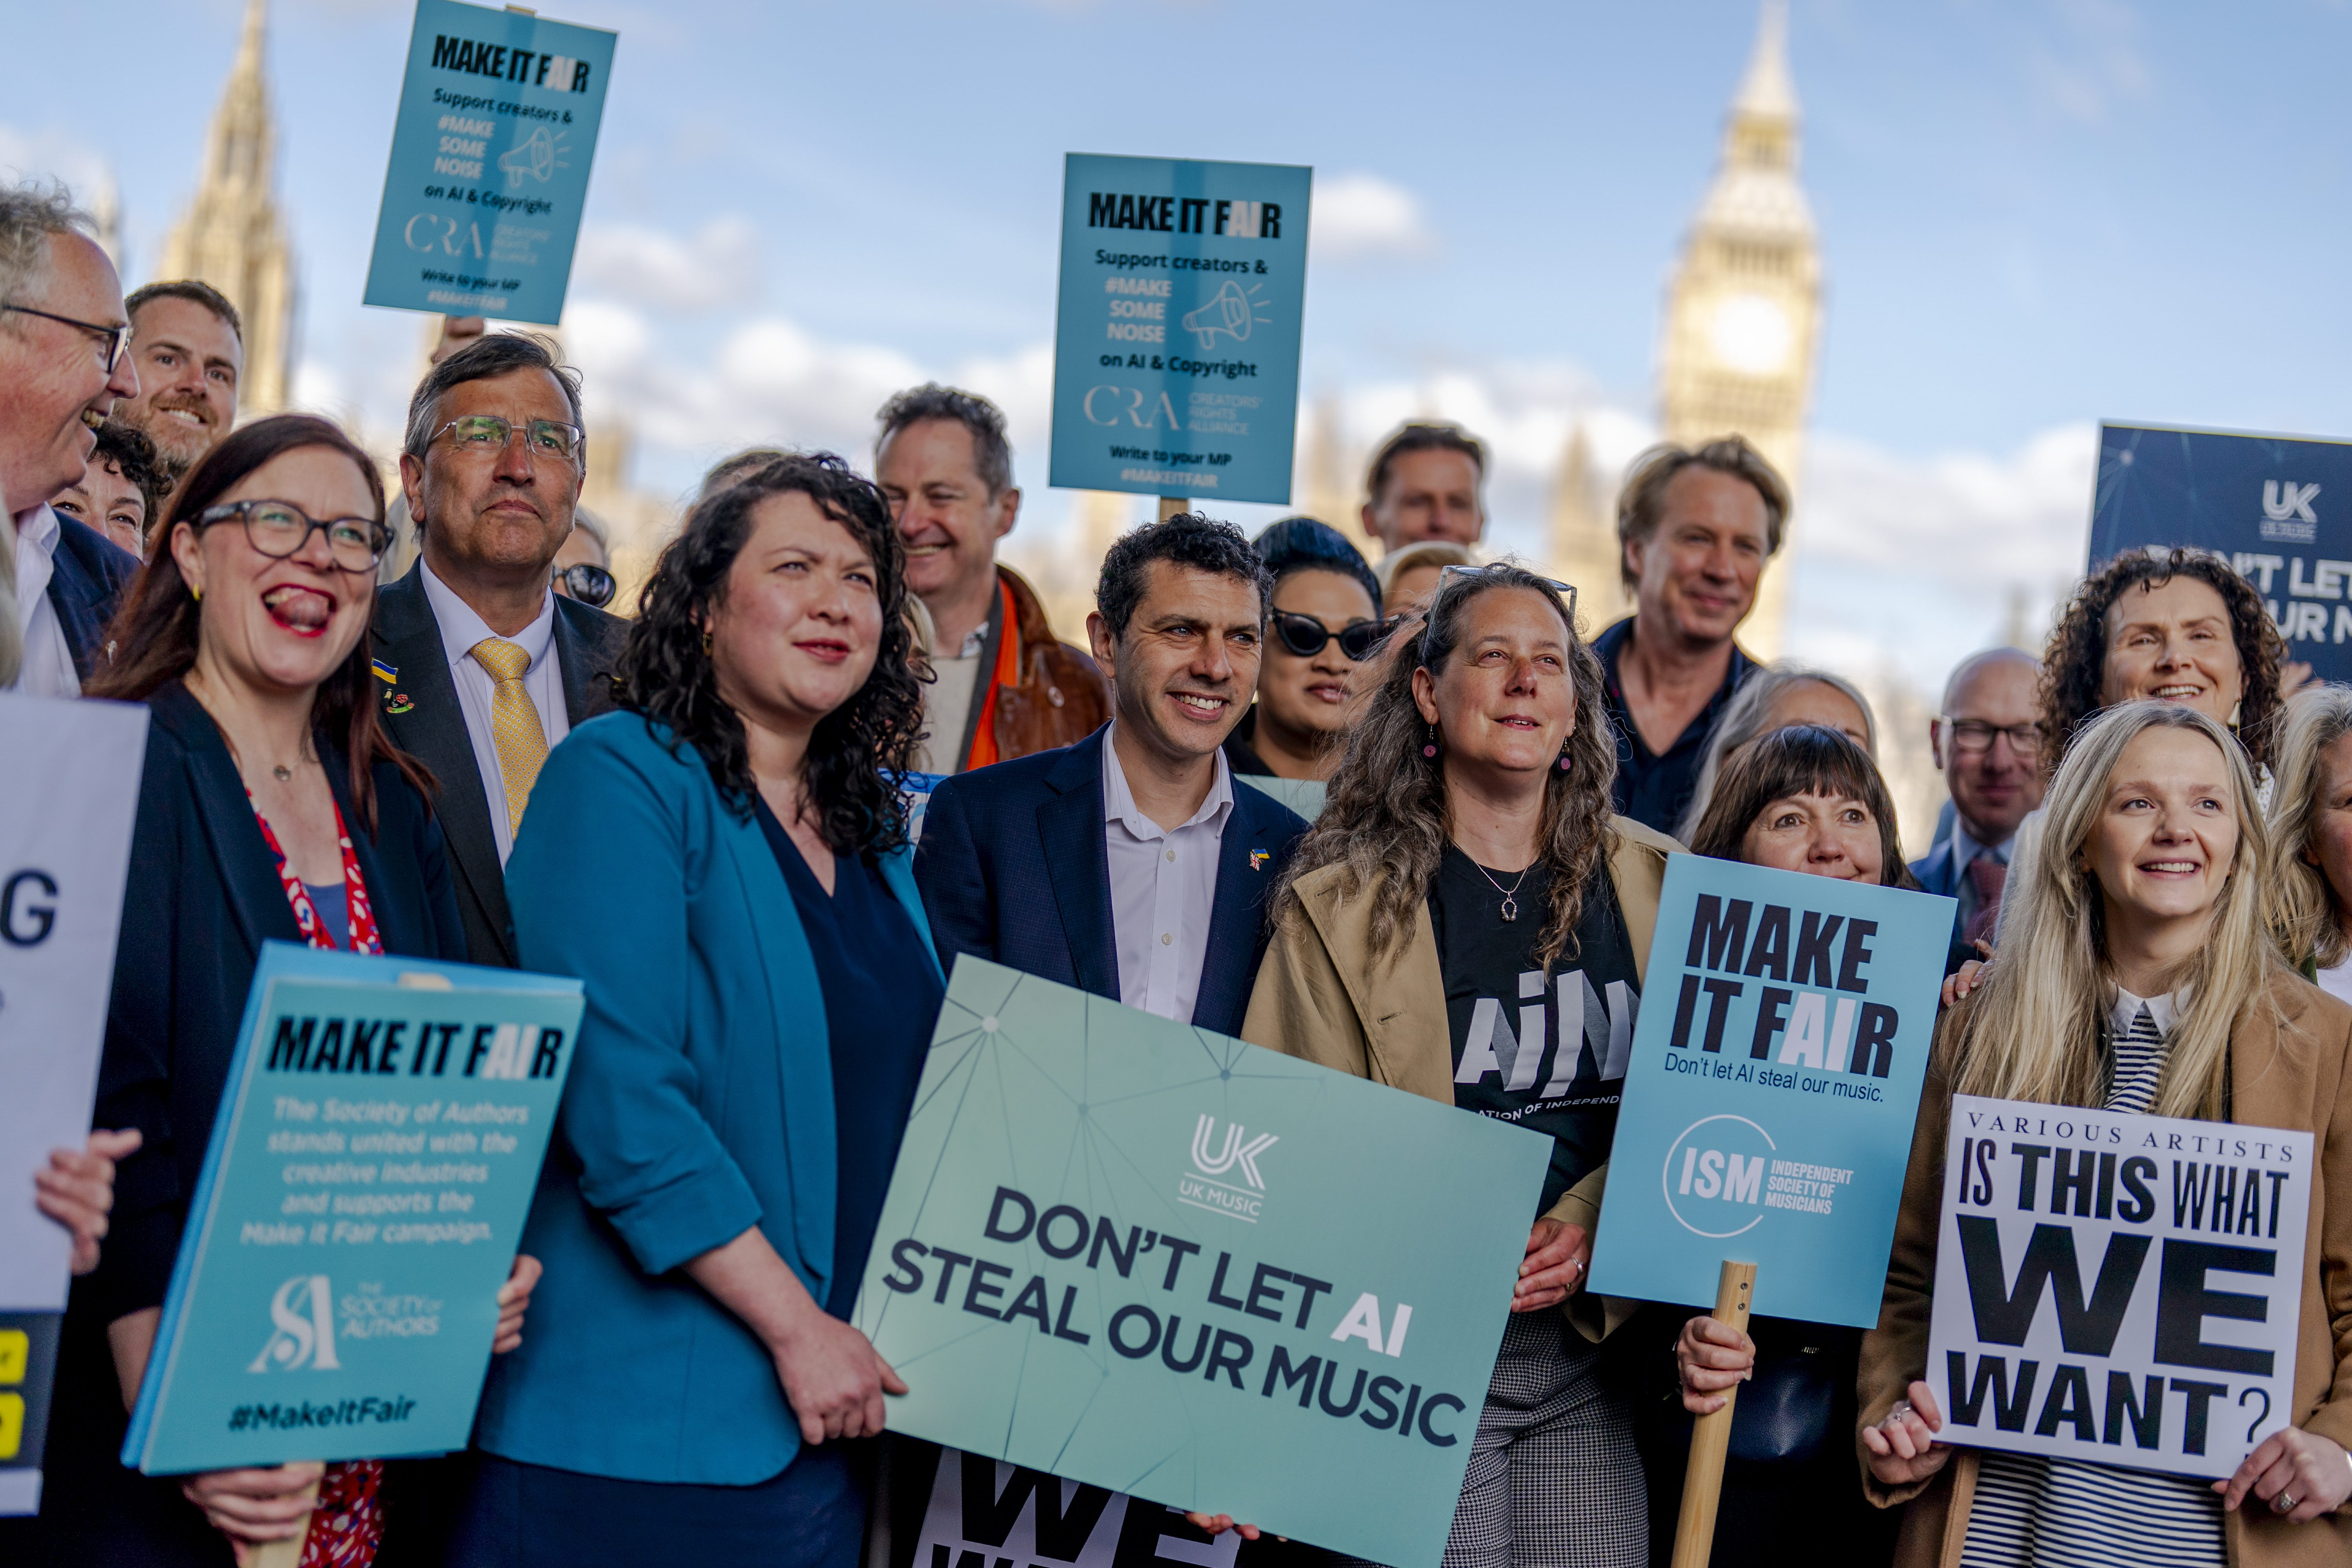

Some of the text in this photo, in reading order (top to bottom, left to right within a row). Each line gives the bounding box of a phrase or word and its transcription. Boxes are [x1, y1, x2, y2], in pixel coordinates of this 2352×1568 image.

[432, 34, 591, 94] MAKE IT FAIR
[433, 87, 573, 124] Support creators &
[438, 114, 496, 138] #MAKE
[439, 136, 487, 159] SOME
[434, 156, 484, 180] NOISE
[425, 185, 553, 216] on AI & Copyright
[1089, 192, 1283, 239] MAKE IT FAIR
[404, 212, 484, 260] CRA
[1095, 249, 1269, 274] Support creators &
[1104, 277, 1173, 297] #MAKE
[1109, 300, 1165, 320] SOME
[1107, 323, 1165, 343] NOISE
[1100, 354, 1258, 379] on AI & Copyright
[1083, 384, 1180, 431] CRA
[1109, 445, 1233, 467] Write to your MP
[1120, 467, 1218, 488] #MAKEITFAIR
[2262, 479, 2321, 524] UK
[1685, 893, 1879, 995] MAKE
[1669, 973, 1900, 1079] IT FAIR
[265, 1014, 566, 1080] MAKE IT FAIR
[1664, 1053, 1884, 1102] Don't let AI steal our music.
[275, 1096, 529, 1127] The Society of Authors
[1524, 1103, 1543, 1114] OF
[267, 1129, 519, 1154] stands united with the
[1191, 1113, 1280, 1191] UK
[1967, 1111, 2293, 1163] VARIOUS ARTISTS
[282, 1160, 489, 1185] creative industries
[1678, 1147, 1765, 1205] ISM
[1767, 1176, 1836, 1198] SOCIETY OF
[1770, 1159, 1854, 1185] INDEPENDENT
[1179, 1180, 1263, 1217] UK MUSIC
[1764, 1191, 1833, 1215] MUSICIANS
[1959, 1137, 2290, 1239] IS THIS WHAT
[281, 1190, 475, 1218] and supports the
[240, 1220, 306, 1245] Make
[331, 1220, 378, 1245] Fair
[982, 1185, 1413, 1359] DON'T LET AI
[339, 1295, 425, 1319] SOCIETY
[1956, 1213, 2278, 1378] WE
[341, 1316, 440, 1339] AUTHORS
[880, 1238, 1467, 1449] STEAL OUR MUSIC
[228, 1394, 417, 1432] #MakeItFair
